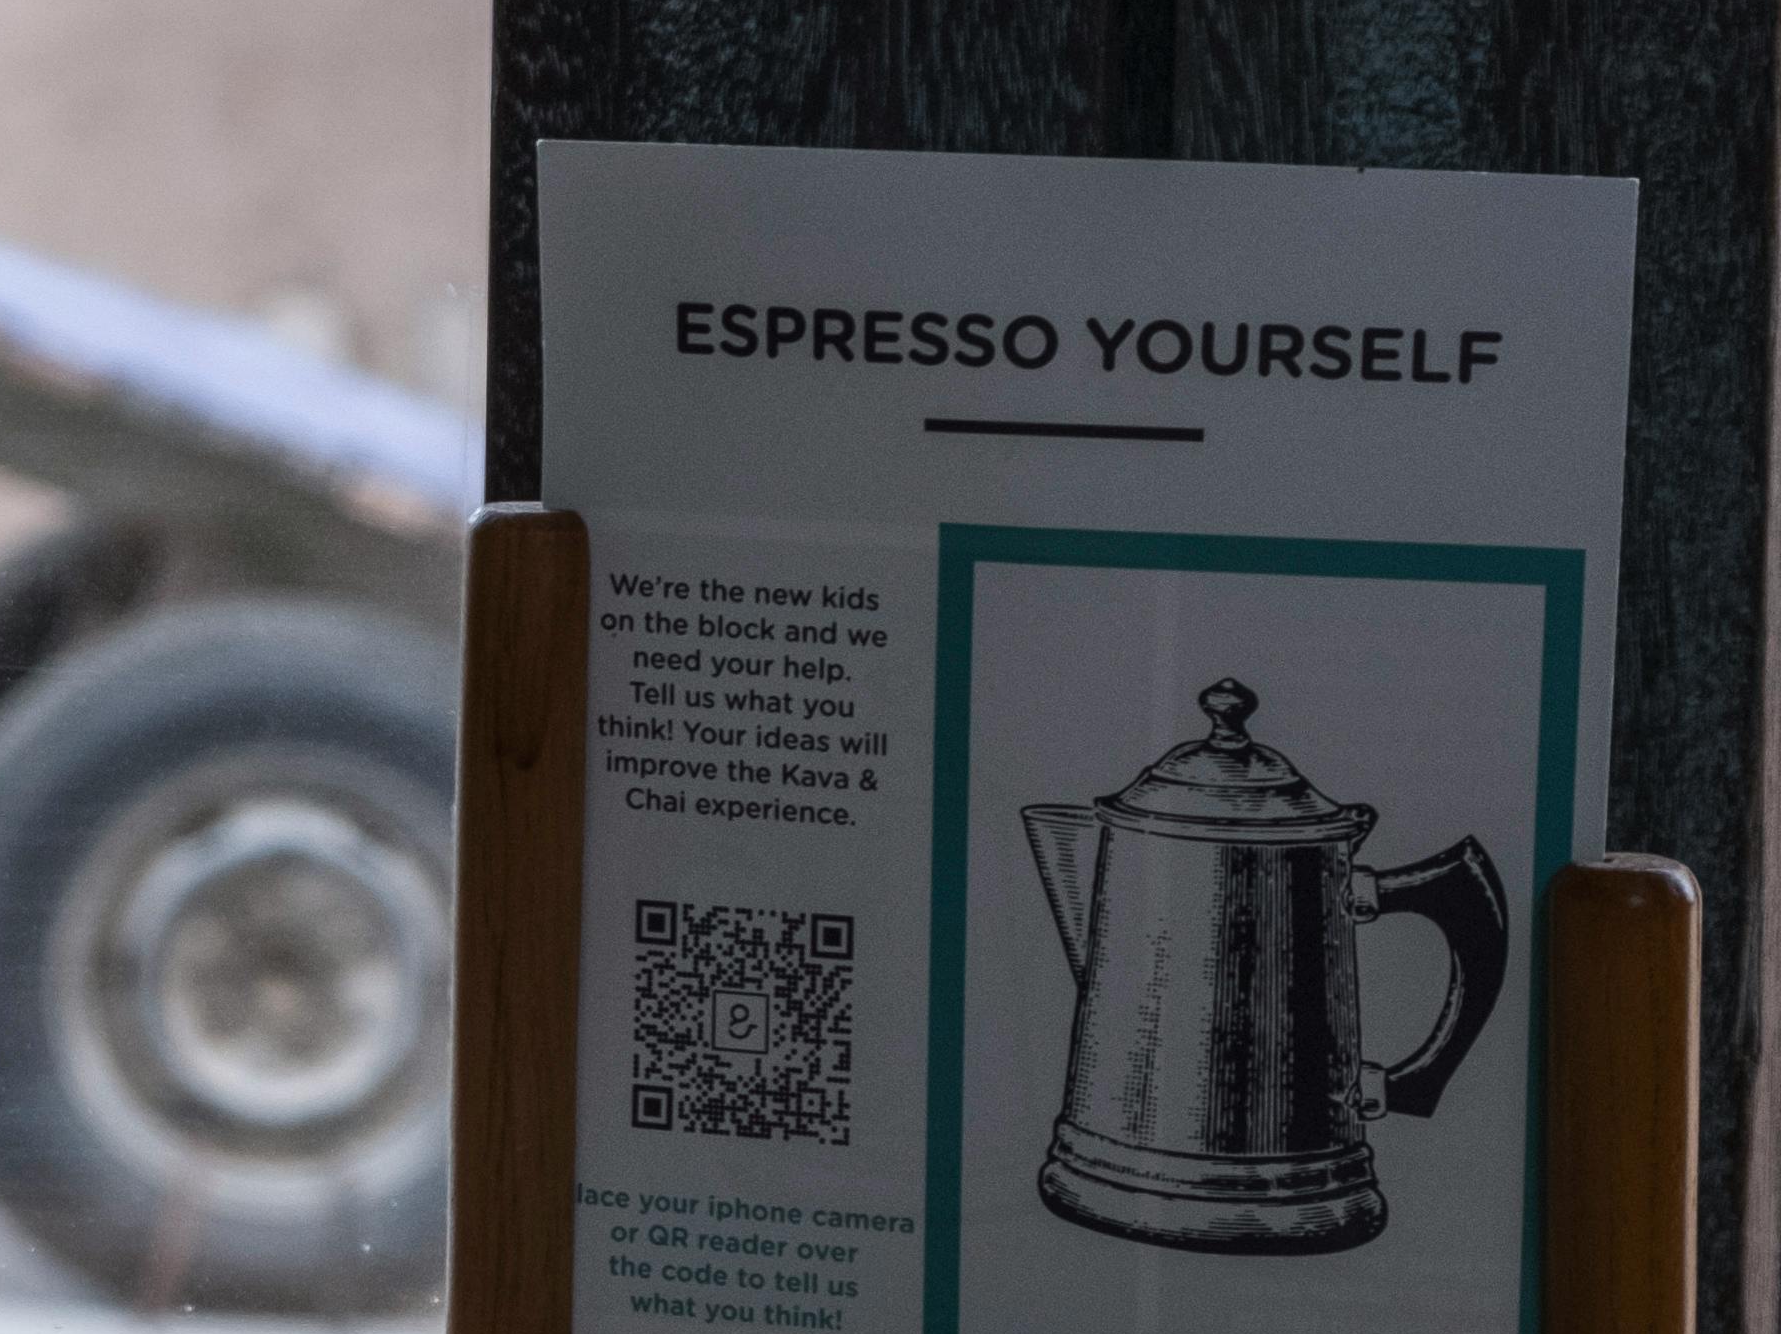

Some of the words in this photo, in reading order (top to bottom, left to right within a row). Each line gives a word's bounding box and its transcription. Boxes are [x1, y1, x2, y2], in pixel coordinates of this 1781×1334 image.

[676, 301, 1059, 370] ESPRESSO
[1085, 317, 1503, 385] YOURSELF
[608, 572, 691, 600] We’re
[699, 578, 746, 604] the
[754, 586, 813, 607] new
[821, 584, 880, 612] kids
[599, 612, 635, 632] on
[643, 610, 689, 636] the
[697, 613, 775, 641] block
[784, 621, 838, 645] and
[847, 628, 888, 649] we
[632, 648, 702, 673] need
[710, 655, 775, 679] your
[783, 654, 852, 686] help.
[628, 680, 676, 706] Tell
[684, 689, 716, 710] us
[724, 688, 793, 715] what
[802, 697, 855, 721] you
[596, 713, 674, 741] think!
[682, 720, 747, 747] Your
[755, 724, 831, 753] ideas
[839, 732, 888, 757] will
[605, 748, 718, 781] improve
[726, 759, 772, 785] the
[781, 763, 850, 790] Kava
[858, 768, 878, 792] &
[624, 786, 686, 814] Chai
[694, 797, 856, 827] experience.
[576, 1182, 631, 1209] lace
[639, 1193, 700, 1216] your
[708, 1194, 804, 1225] iphone
[811, 1209, 915, 1235] camera
[610, 1225, 640, 1244] or
[647, 1223, 690, 1249] QR
[697, 1233, 788, 1258] reader
[796, 1242, 859, 1264] over
[608, 1254, 653, 1280] the
[661, 1262, 729, 1287] code
[736, 1267, 766, 1291] to
[774, 1271, 819, 1295] tell
[827, 1279, 859, 1299] us
[630, 1292, 697, 1318] what
[704, 1302, 755, 1325] you
[763, 1303, 843, 1331] think!
